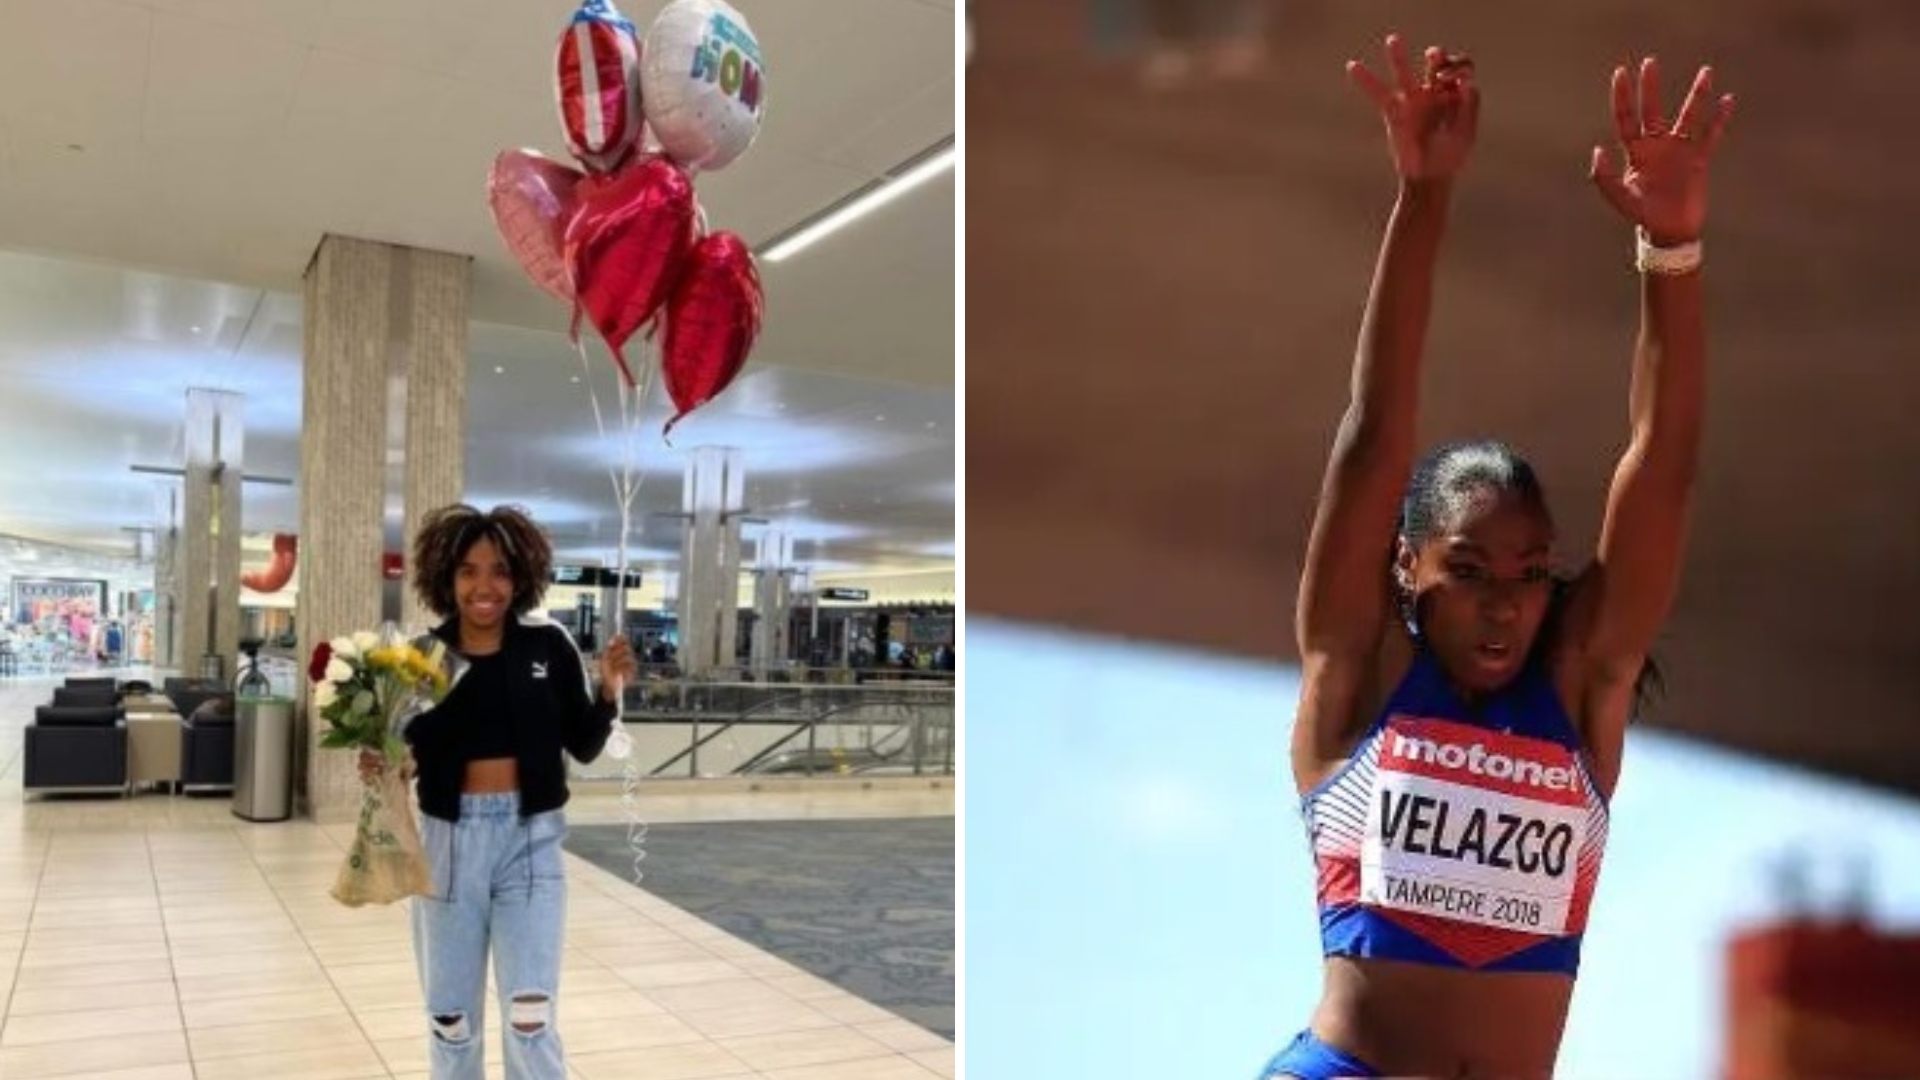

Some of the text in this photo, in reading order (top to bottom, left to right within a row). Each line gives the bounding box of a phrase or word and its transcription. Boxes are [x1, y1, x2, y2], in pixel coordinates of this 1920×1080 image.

[691, 35, 763, 113] HOM
[1391, 733, 1578, 793] motonet
[1380, 789, 1573, 878] VELAZCO
[1384, 875, 1543, 927] TAMPERE 2018
